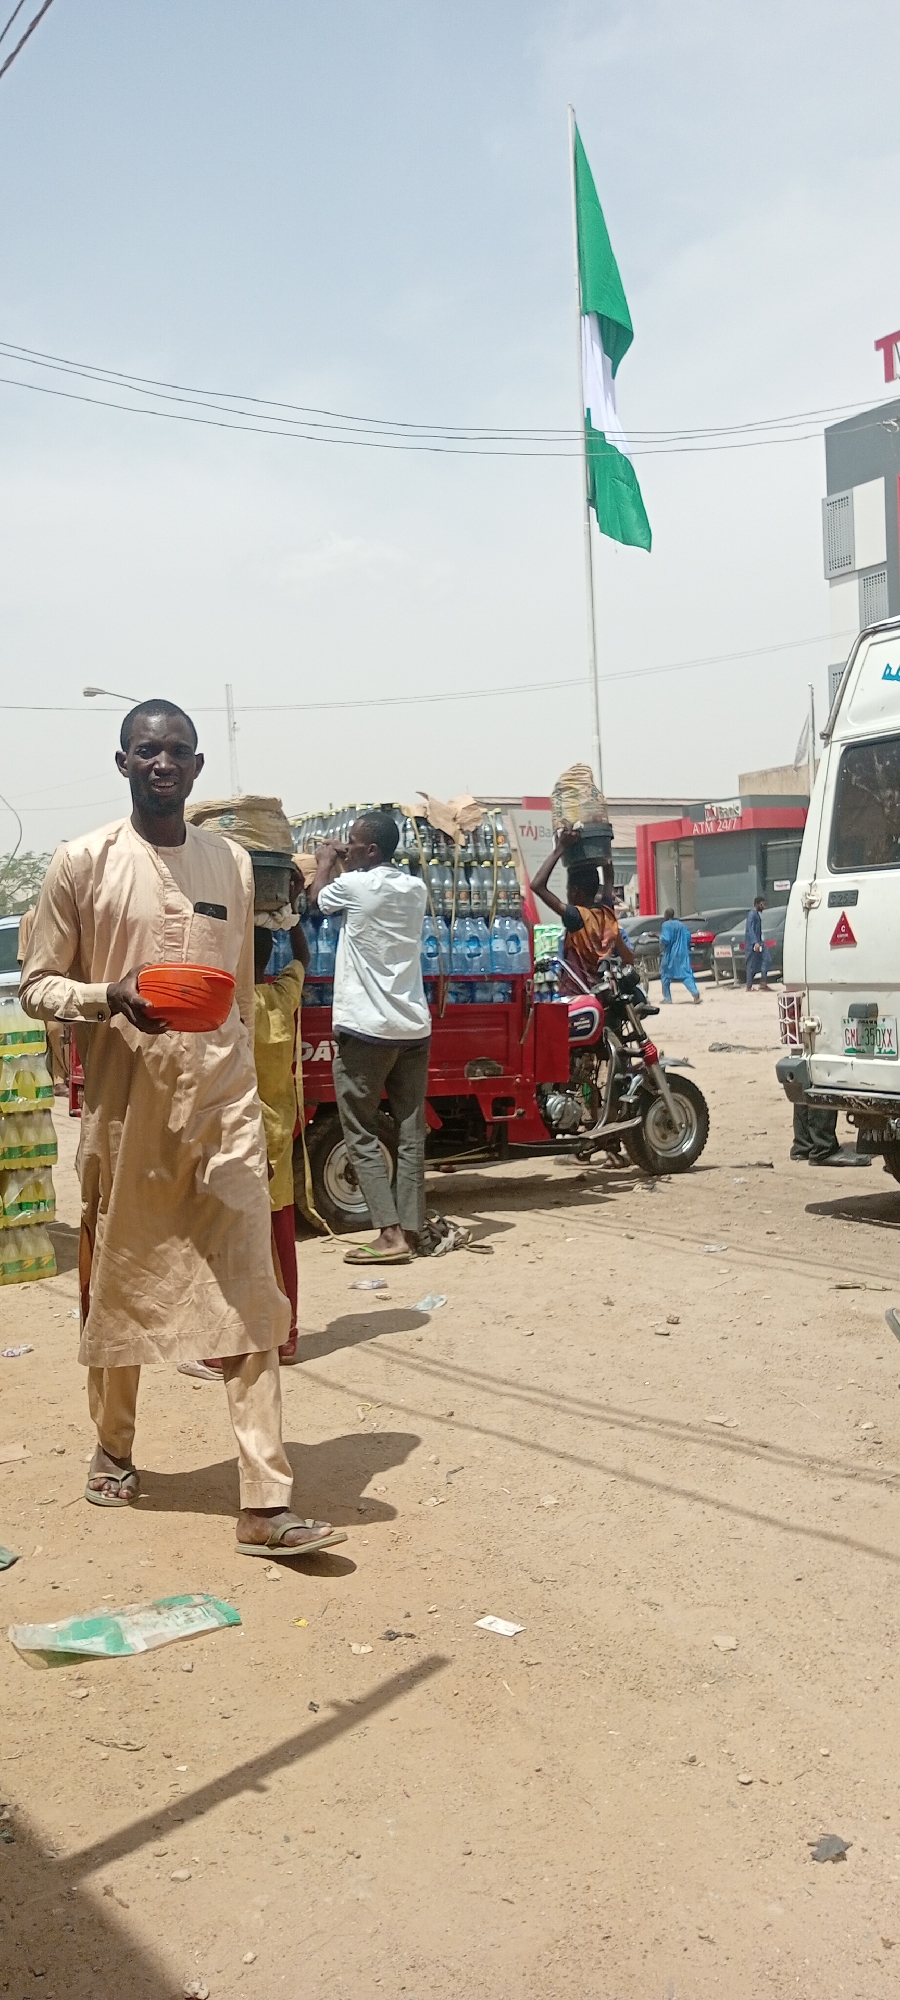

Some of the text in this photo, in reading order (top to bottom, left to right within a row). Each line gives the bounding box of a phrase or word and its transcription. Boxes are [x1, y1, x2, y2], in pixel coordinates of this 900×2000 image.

[519, 823, 552, 841] TAJBa
[693, 817, 737, 835] ATM 24/7
